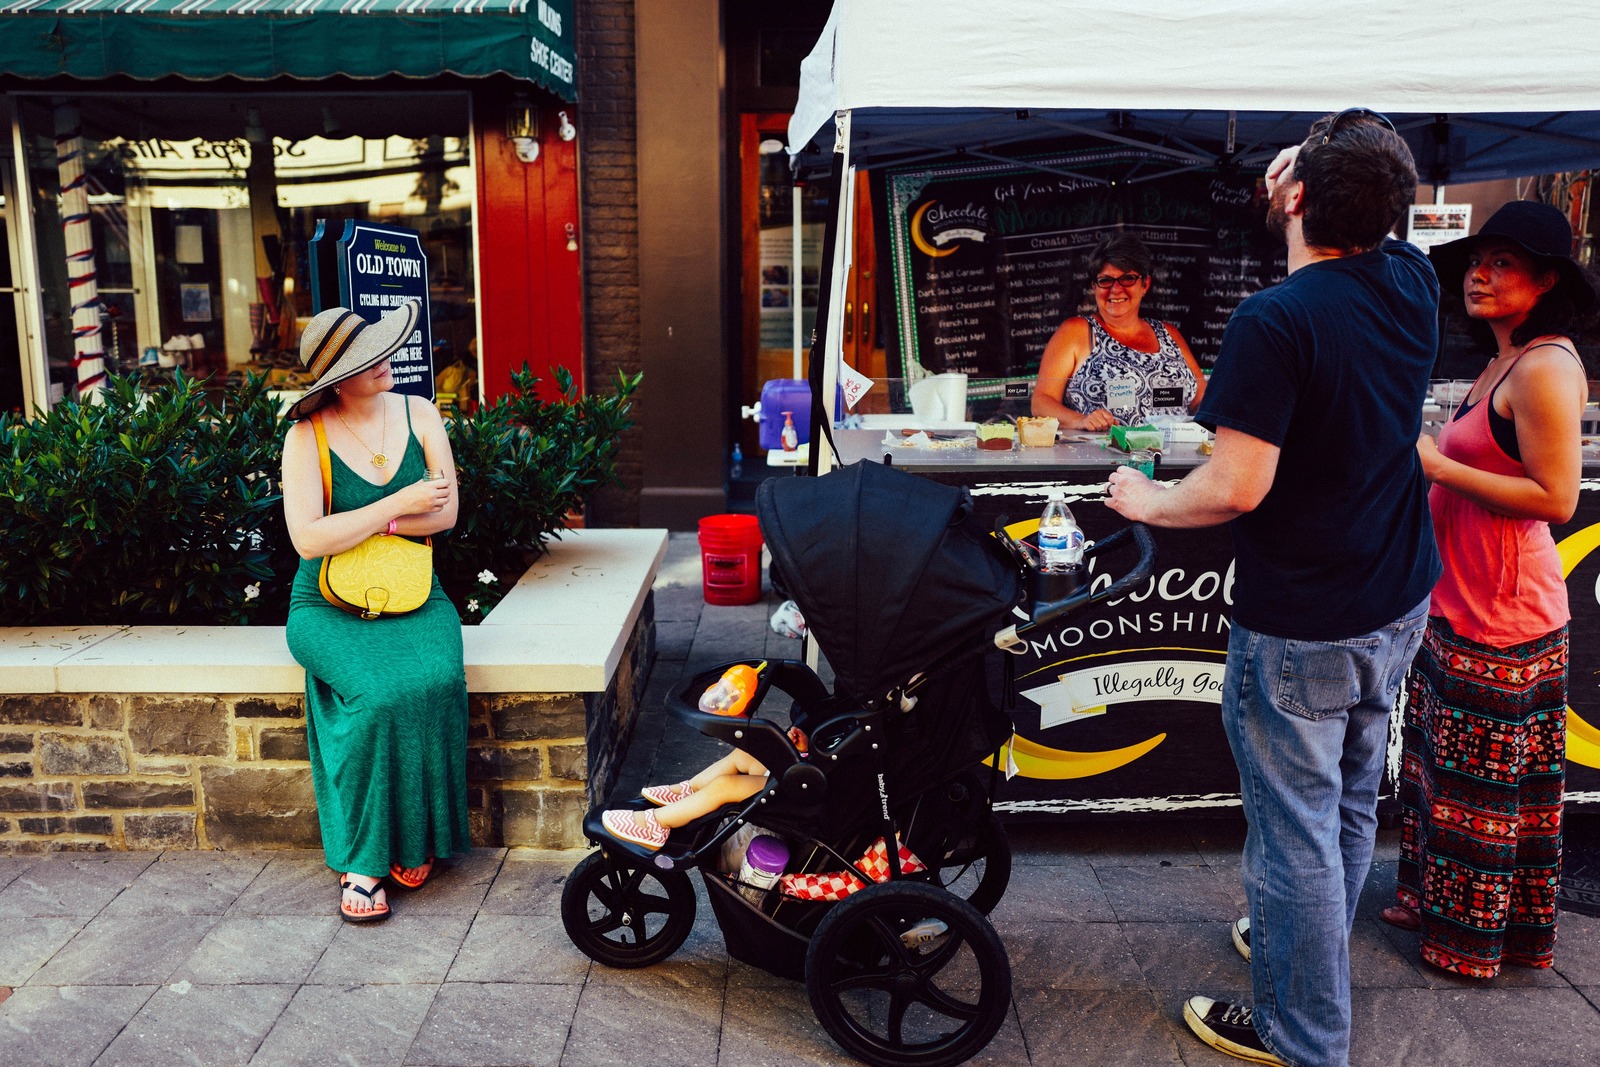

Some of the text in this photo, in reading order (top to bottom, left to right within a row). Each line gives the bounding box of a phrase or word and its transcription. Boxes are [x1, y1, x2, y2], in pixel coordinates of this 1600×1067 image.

[926, 202, 988, 223] Chocolate
[374, 239, 406, 253] Welcome to
[1030, 234, 1068, 249] Create
[356, 253, 421, 278] OLD TOWN
[359, 293, 379, 307] CYCLING
[380, 294, 390, 307] AND
[410, 346, 423, 361] HERE
[1093, 666, 1185, 697] Illegally
[877, 773, 890, 821] baby trend
